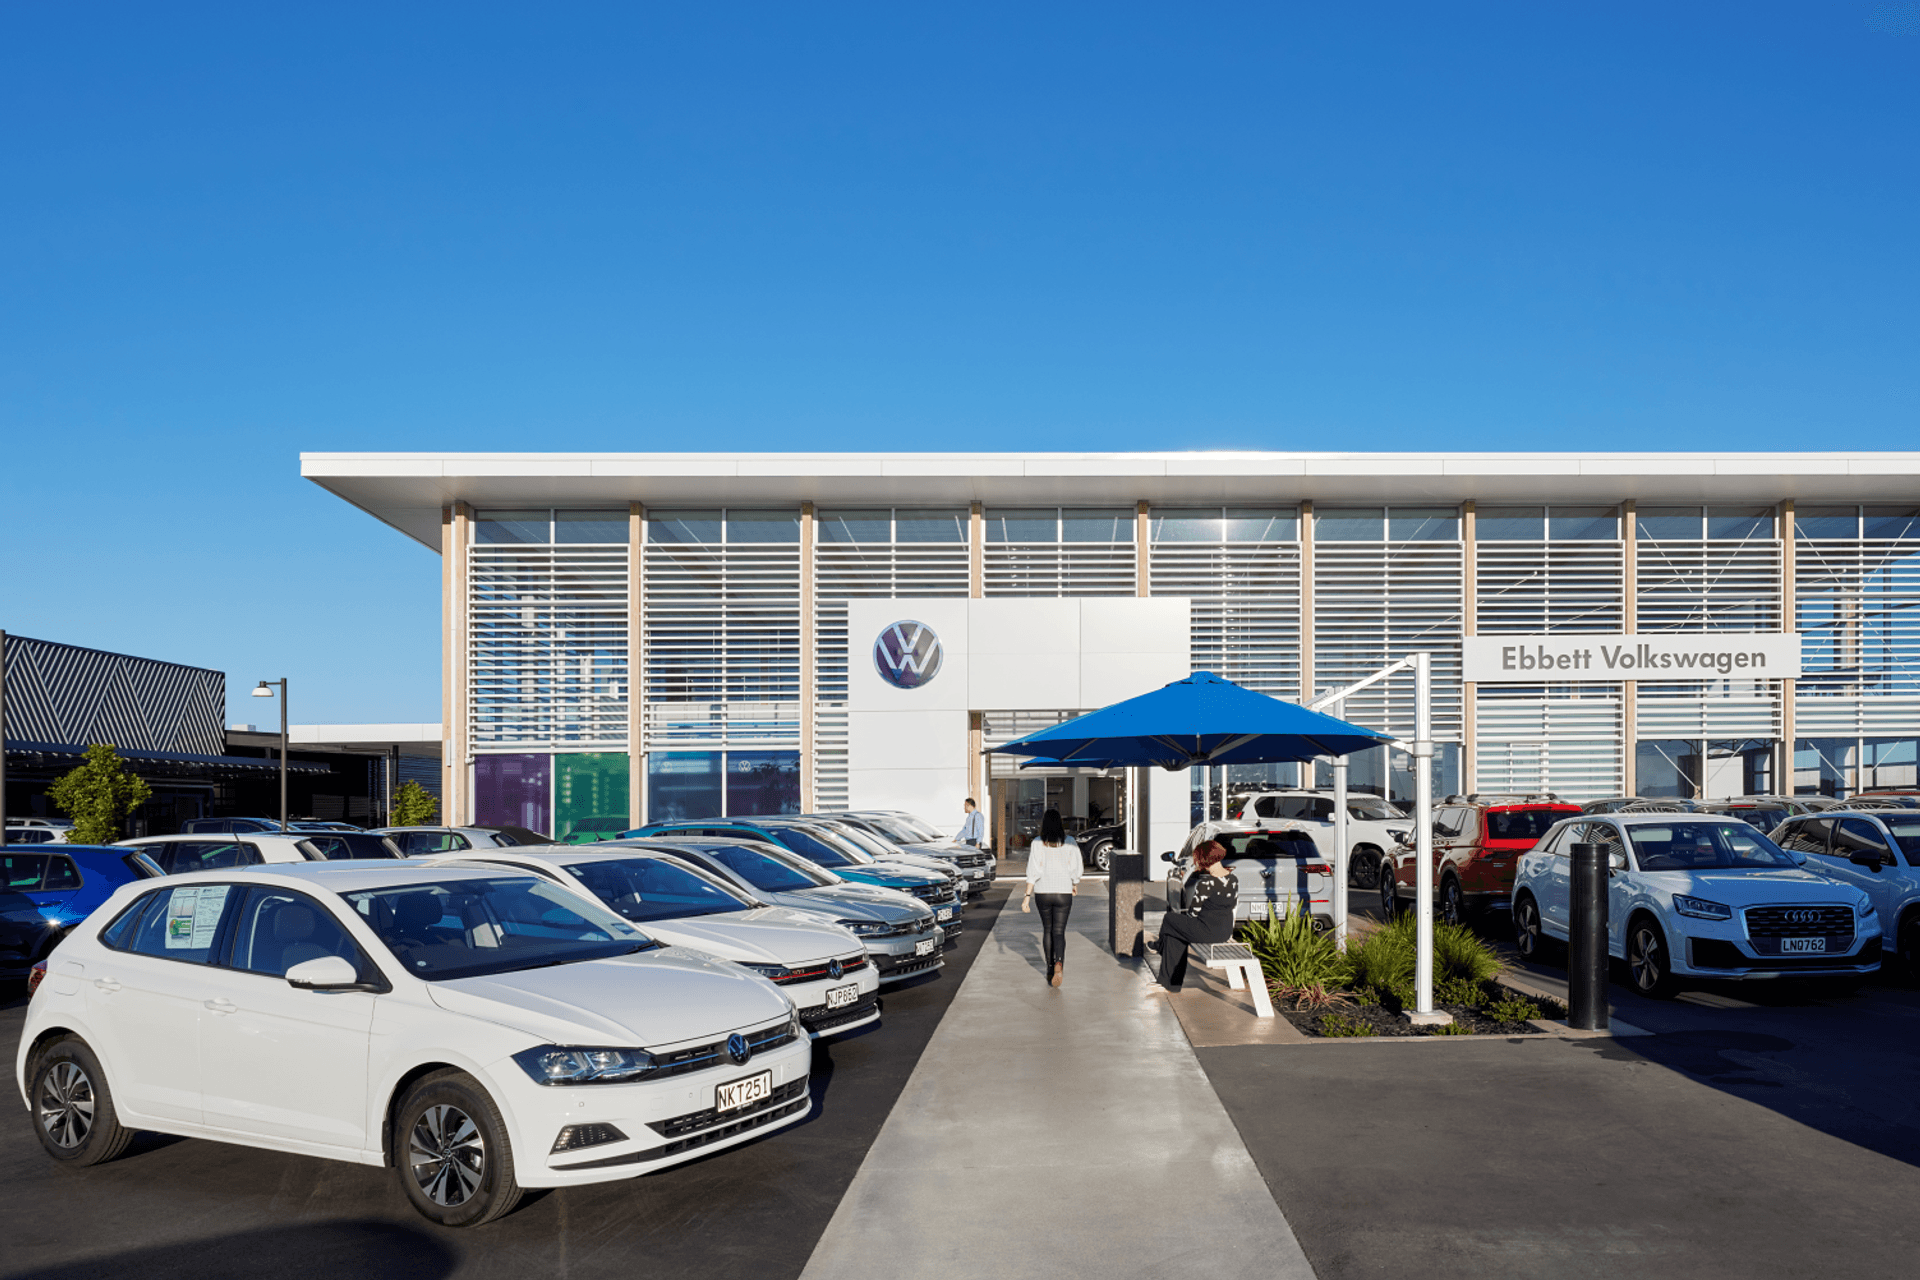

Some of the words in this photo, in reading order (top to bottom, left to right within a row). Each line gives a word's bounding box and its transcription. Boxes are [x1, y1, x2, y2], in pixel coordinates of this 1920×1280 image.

[873, 620, 943, 689] VW
[1502, 645, 1592, 670] Ebbett
[1600, 643, 1766, 674] Volkswagen
[1783, 939, 1824, 952] LNQ762
[718, 1075, 769, 1109] NKT251
